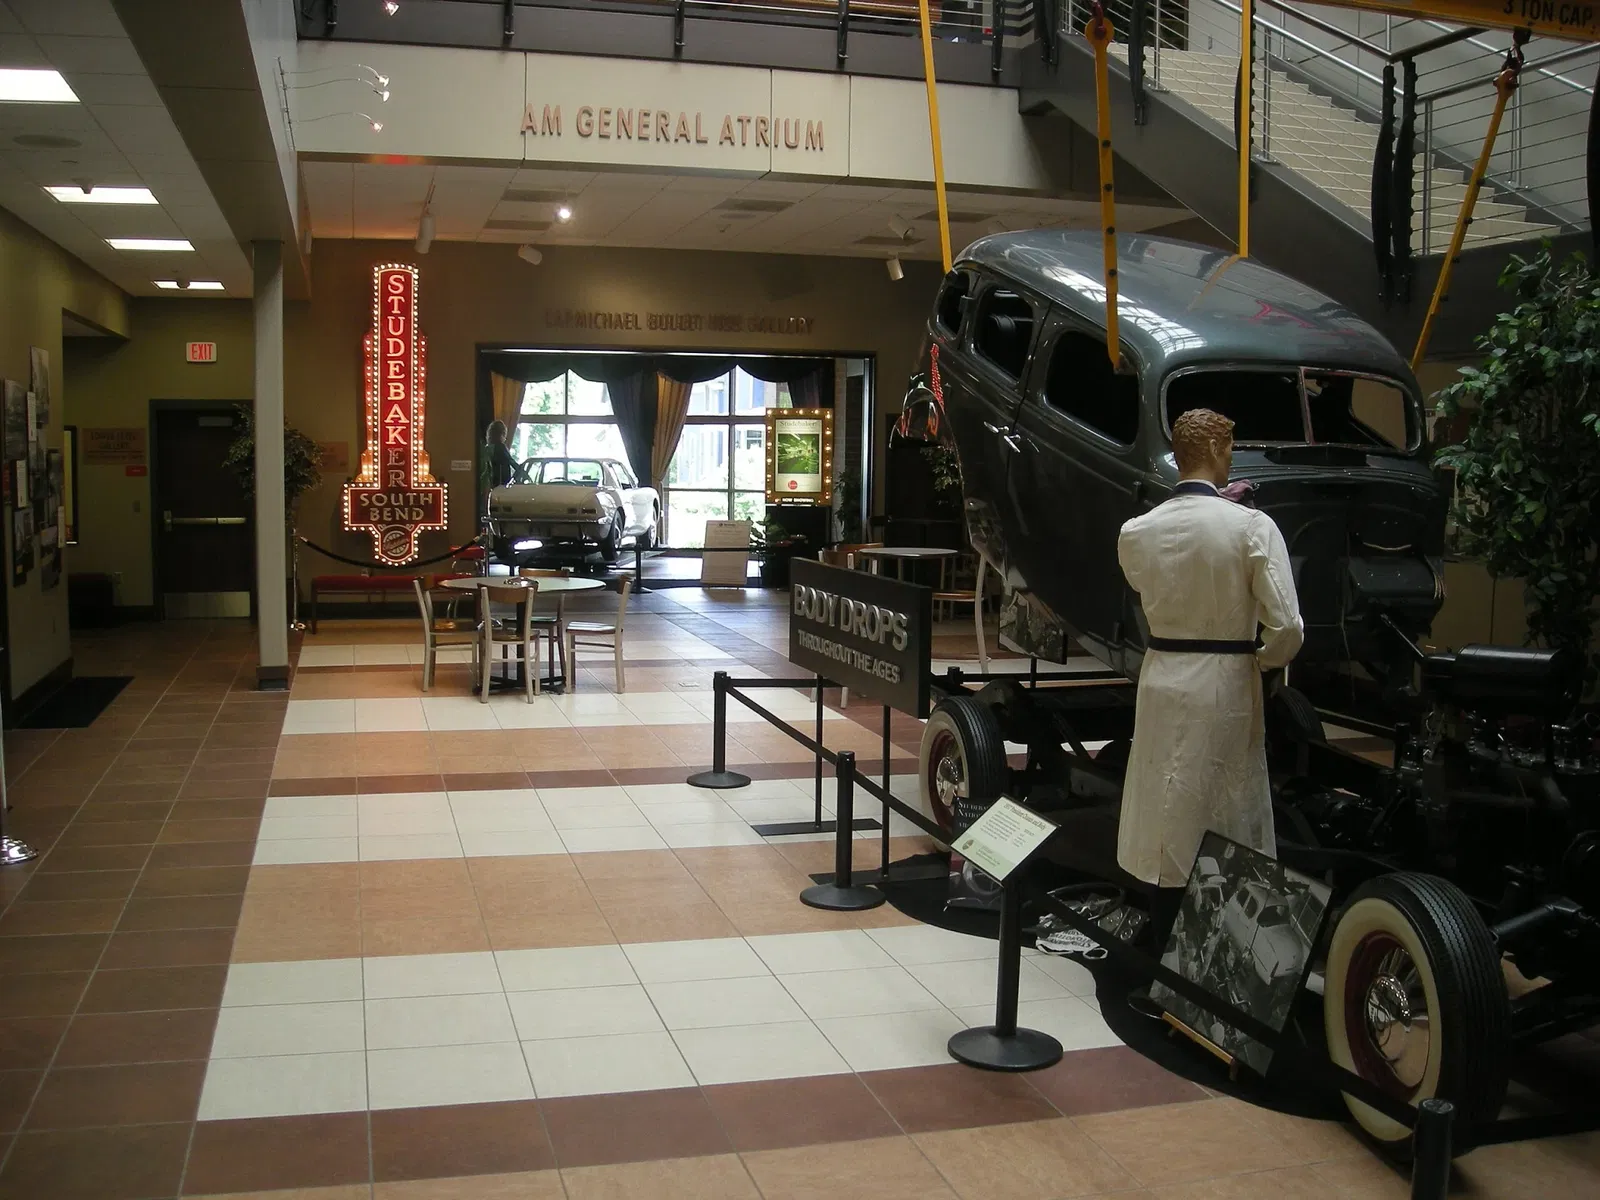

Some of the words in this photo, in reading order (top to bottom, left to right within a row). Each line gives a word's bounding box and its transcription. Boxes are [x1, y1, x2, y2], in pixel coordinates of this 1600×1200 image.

[520, 103, 563, 136] AM
[576, 105, 709, 143] GENERAL
[719, 114, 825, 151] ATRIUM
[191, 344, 213, 360] EXIT
[384, 275, 409, 487] STUDEBAKER
[360, 493, 433, 506] SOUTH
[369, 508, 424, 521] BEND
[794, 583, 839, 627] BODY
[840, 597, 908, 651] DROPS
[797, 629, 853, 665] THROUGHOUT
[853, 650, 872, 673] THE
[872, 656, 900, 684] AGES
